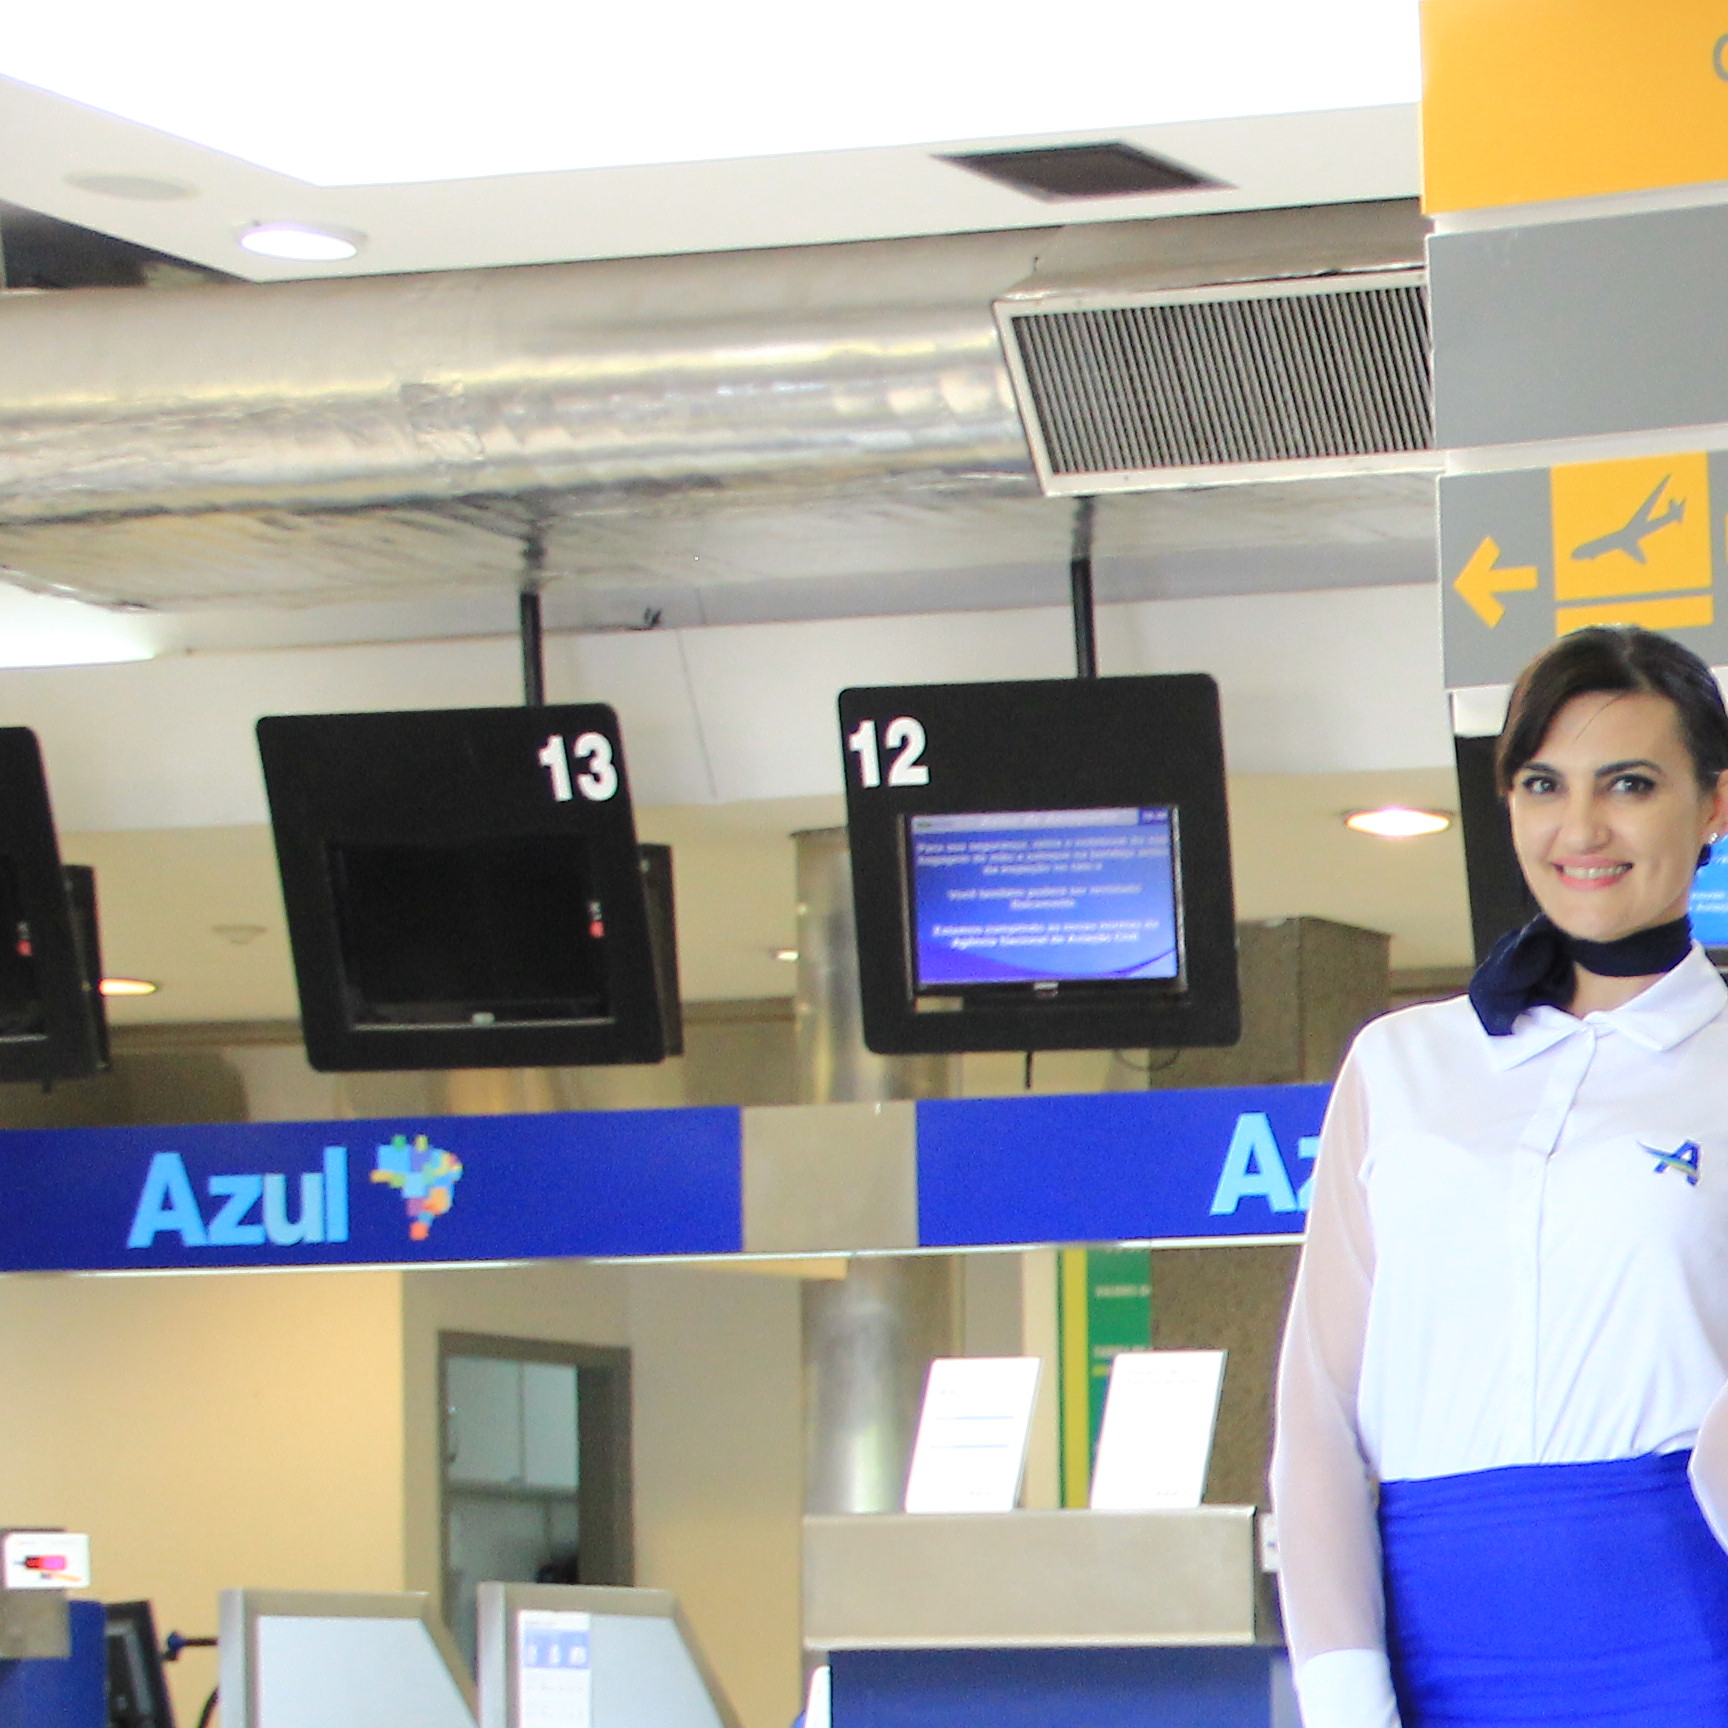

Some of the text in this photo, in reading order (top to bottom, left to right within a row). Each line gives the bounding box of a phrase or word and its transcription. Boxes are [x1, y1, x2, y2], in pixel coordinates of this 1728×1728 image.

[538, 731, 620, 803] 13
[848, 715, 930, 788] 12
[126, 1145, 350, 1250] Azul
